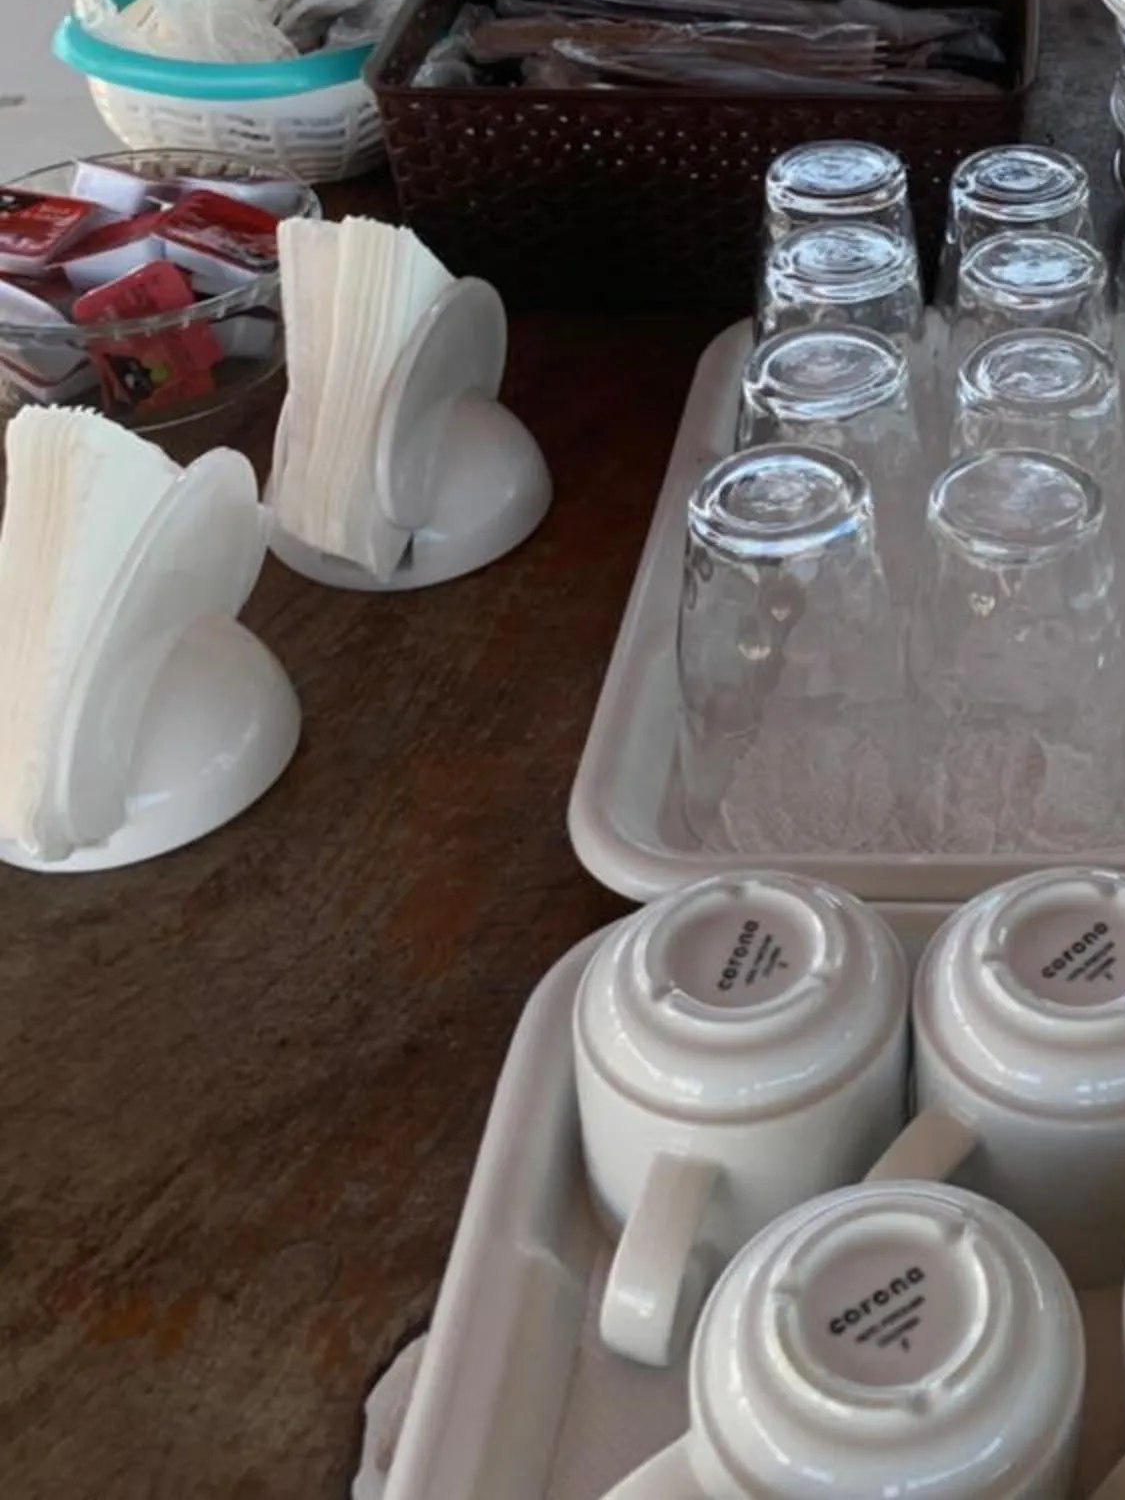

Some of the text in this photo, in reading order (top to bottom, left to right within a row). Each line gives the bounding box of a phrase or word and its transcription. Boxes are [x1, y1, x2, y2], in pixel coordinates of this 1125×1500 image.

[717, 920, 760, 991] corona
[1041, 921, 1109, 978] corona
[828, 1266, 926, 1335] corona
